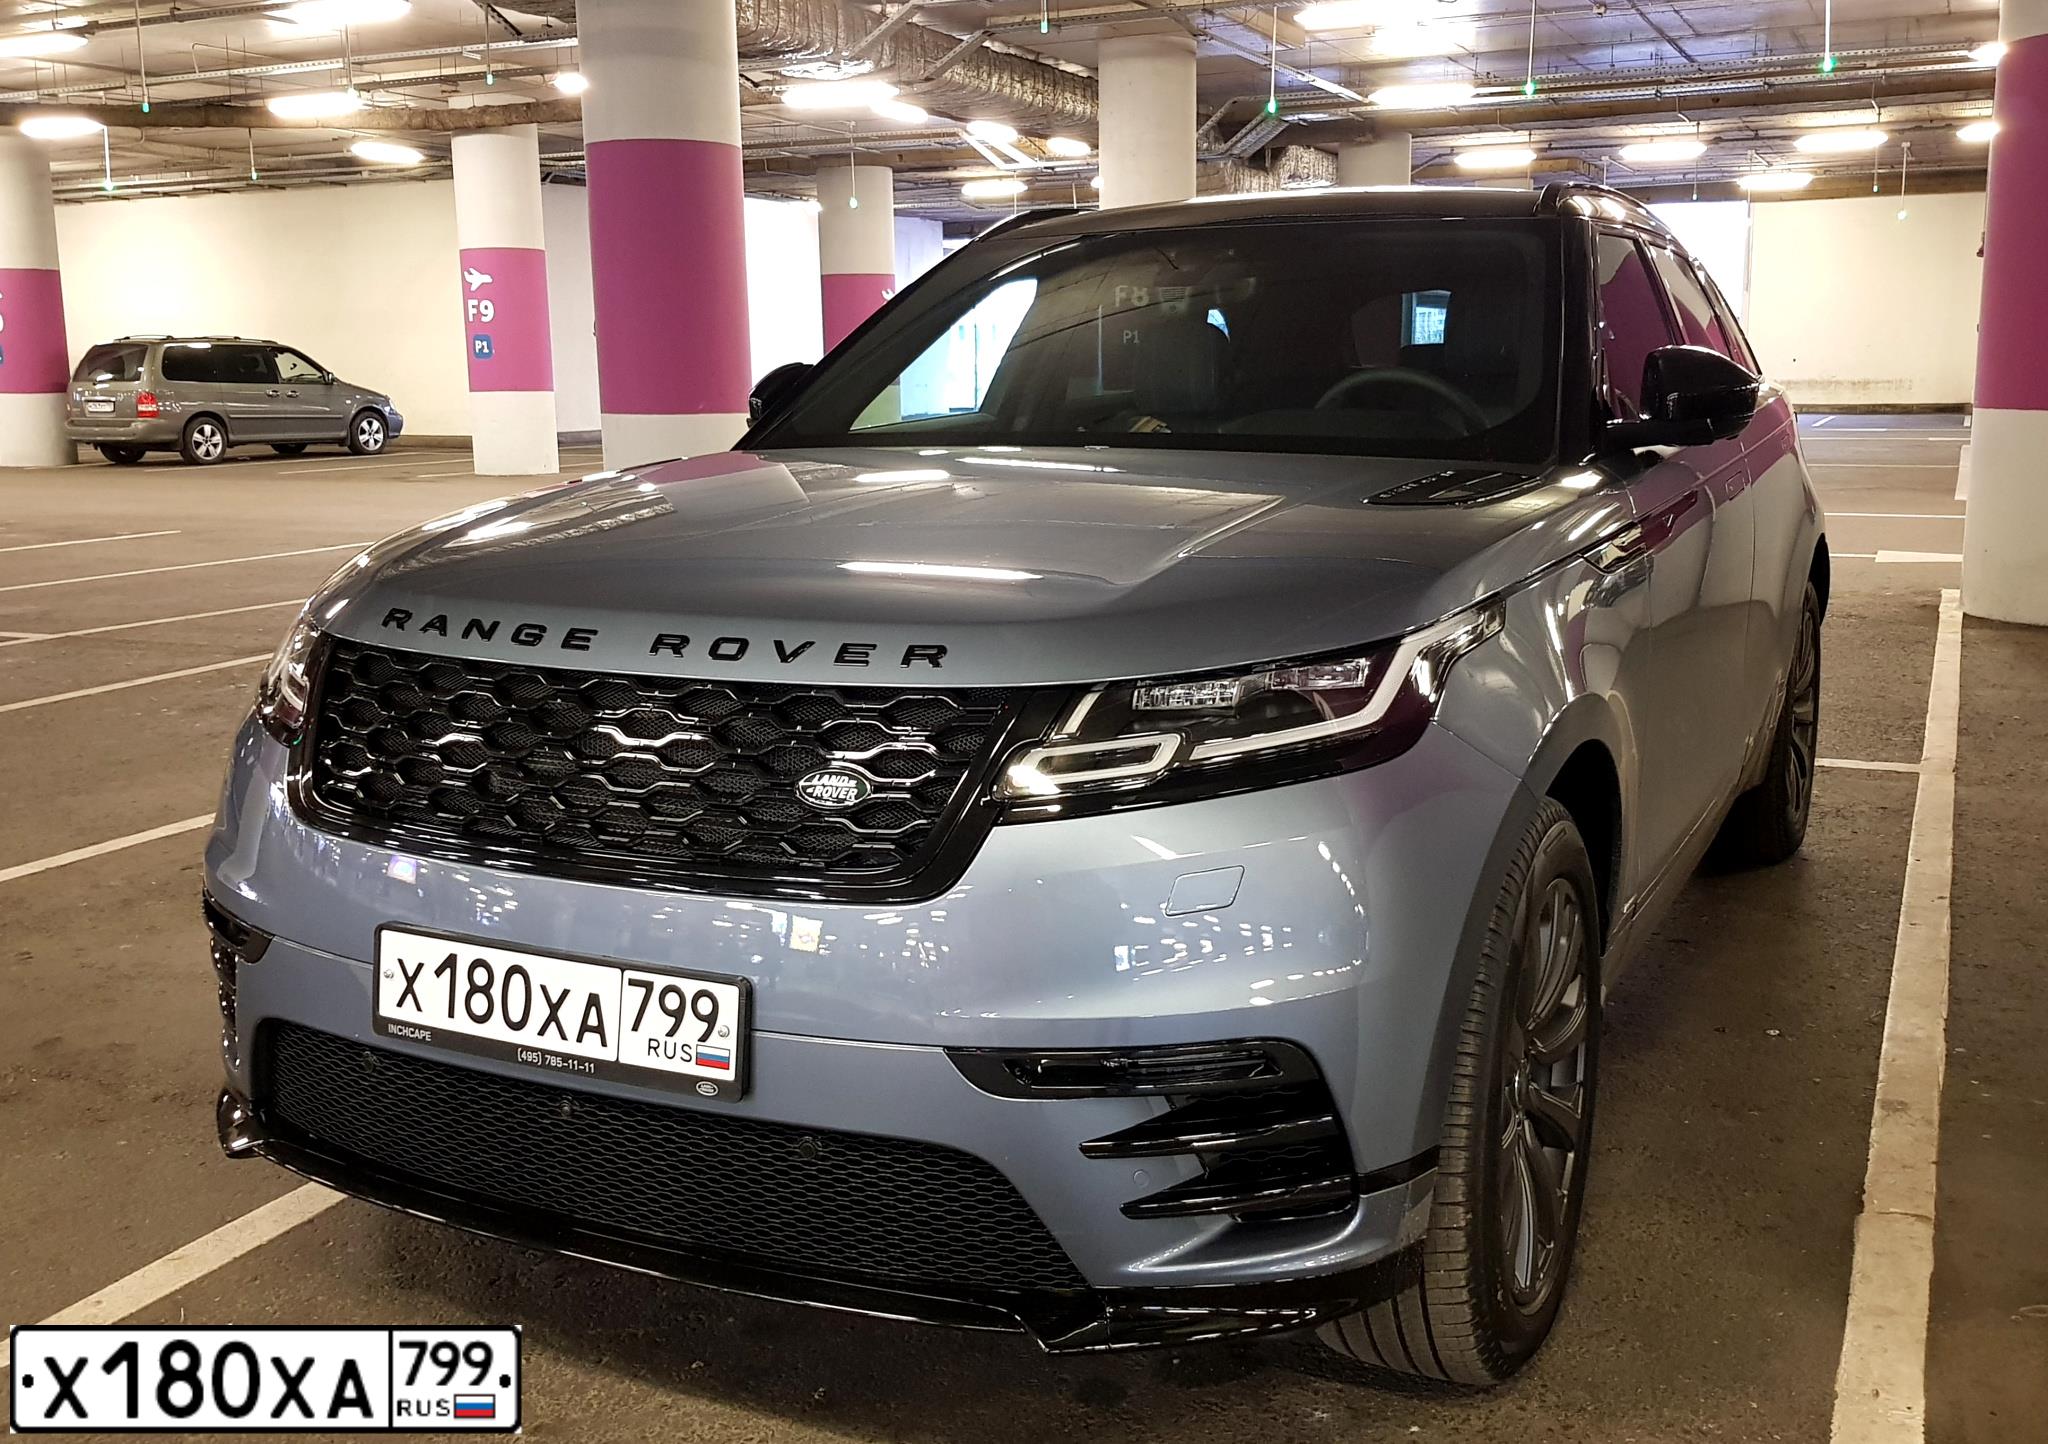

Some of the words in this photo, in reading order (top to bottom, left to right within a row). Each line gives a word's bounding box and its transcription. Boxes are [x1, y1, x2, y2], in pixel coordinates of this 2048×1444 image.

[467, 298, 495, 323] F9
[474, 339, 490, 353] P1
[1122, 329, 1140, 343] P1
[381, 607, 599, 651] RANGE
[648, 633, 948, 668] ROVER
[811, 774, 850, 787] LAND
[812, 785, 858, 801] ROVER
[396, 952, 609, 1047] X180XA
[627, 978, 720, 1043] 799
[388, 1023, 432, 1042] INCHCAPE
[517, 1047, 542, 1066] (495)
[545, 1054, 595, 1074] 785-11-11
[647, 1037, 693, 1063] RUS
